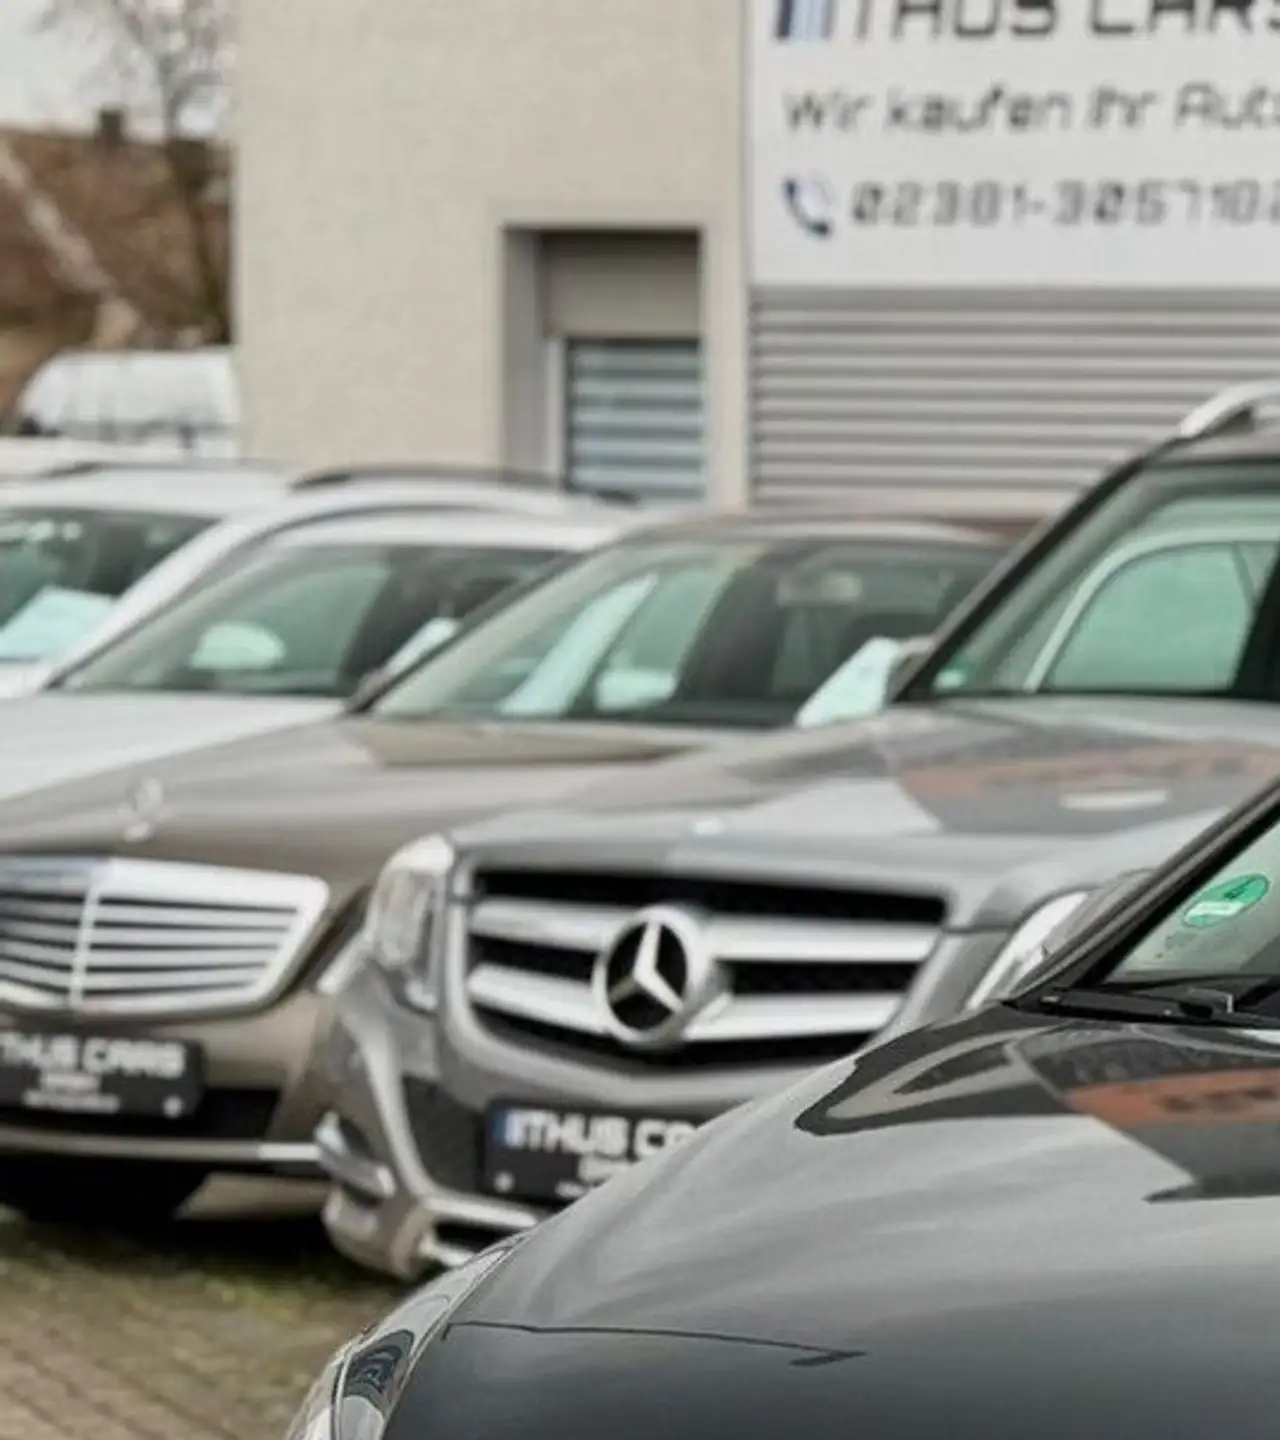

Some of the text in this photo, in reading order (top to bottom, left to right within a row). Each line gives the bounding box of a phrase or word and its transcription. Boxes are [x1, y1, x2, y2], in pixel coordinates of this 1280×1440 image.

[782, 86, 877, 132] Wir
[884, 82, 1074, 134] kaufen
[1085, 84, 1159, 132] Ihr
